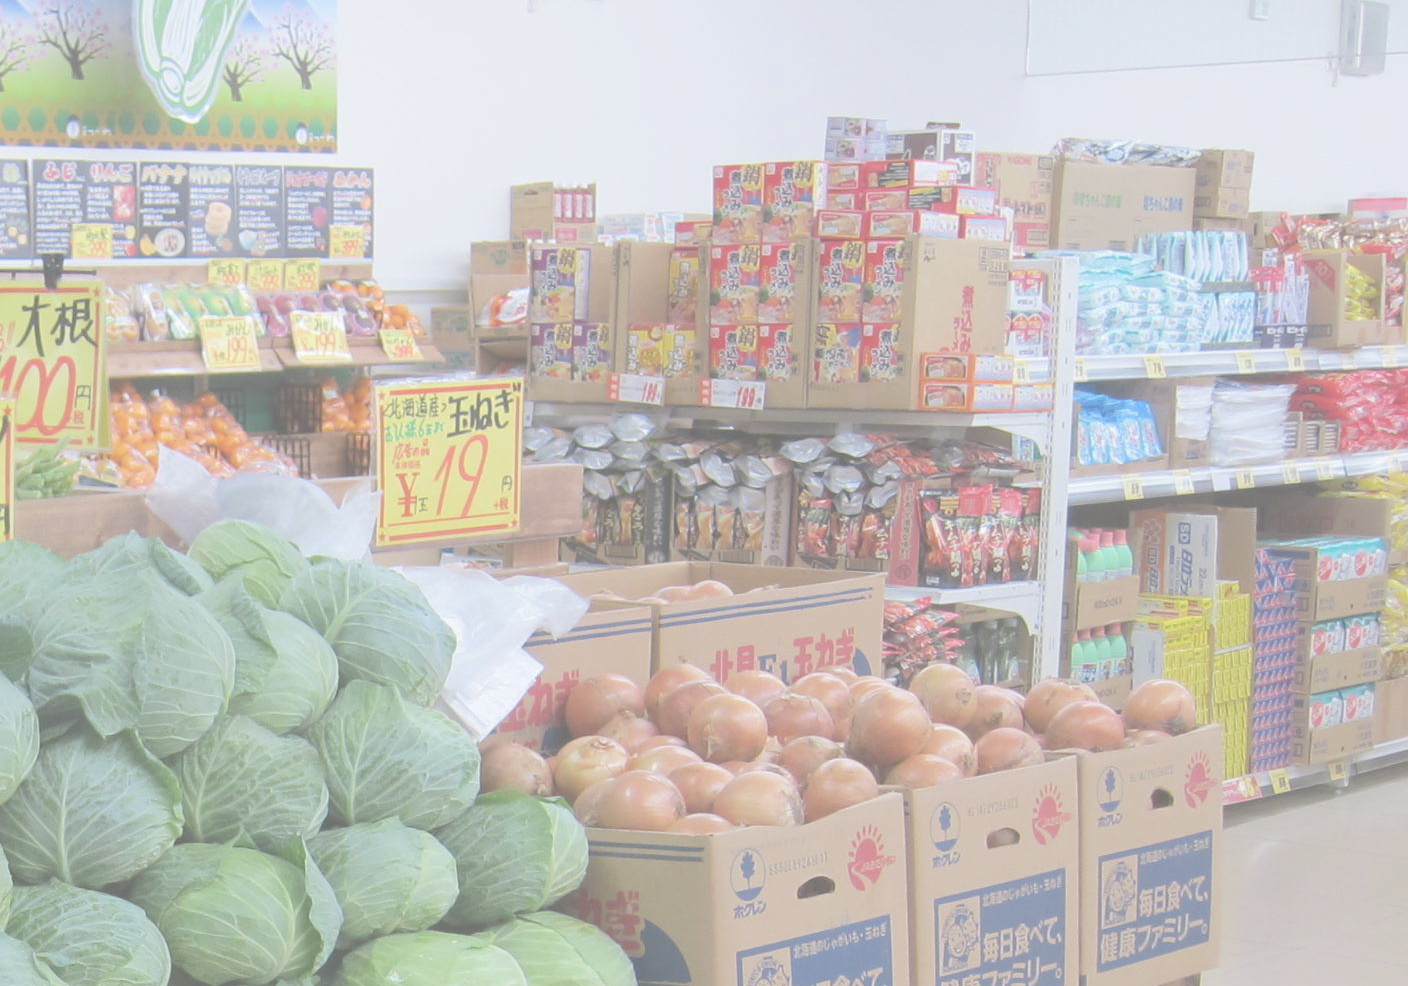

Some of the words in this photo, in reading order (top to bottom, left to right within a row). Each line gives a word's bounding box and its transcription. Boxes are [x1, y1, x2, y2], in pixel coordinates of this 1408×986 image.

[42, 160, 78, 182] ふじ
[89, 162, 136, 184] りんご
[332, 169, 373, 189] みかん
[15, 294, 99, 358] 大根
[74, 385, 92, 410] 円
[446, 382, 522, 438] 玉ねぎ
[395, 472, 420, 518] ¥
[433, 434, 489, 519] 19
[500, 474, 514, 493] 円
[931, 852, 962, 869] ホクレン
[1139, 874, 1210, 918] 毎日食べて、
[732, 900, 767, 920] ホクレン
[983, 916, 1063, 963] 毎日食べて、
[1100, 913, 1210, 965] 健康ファミリー。
